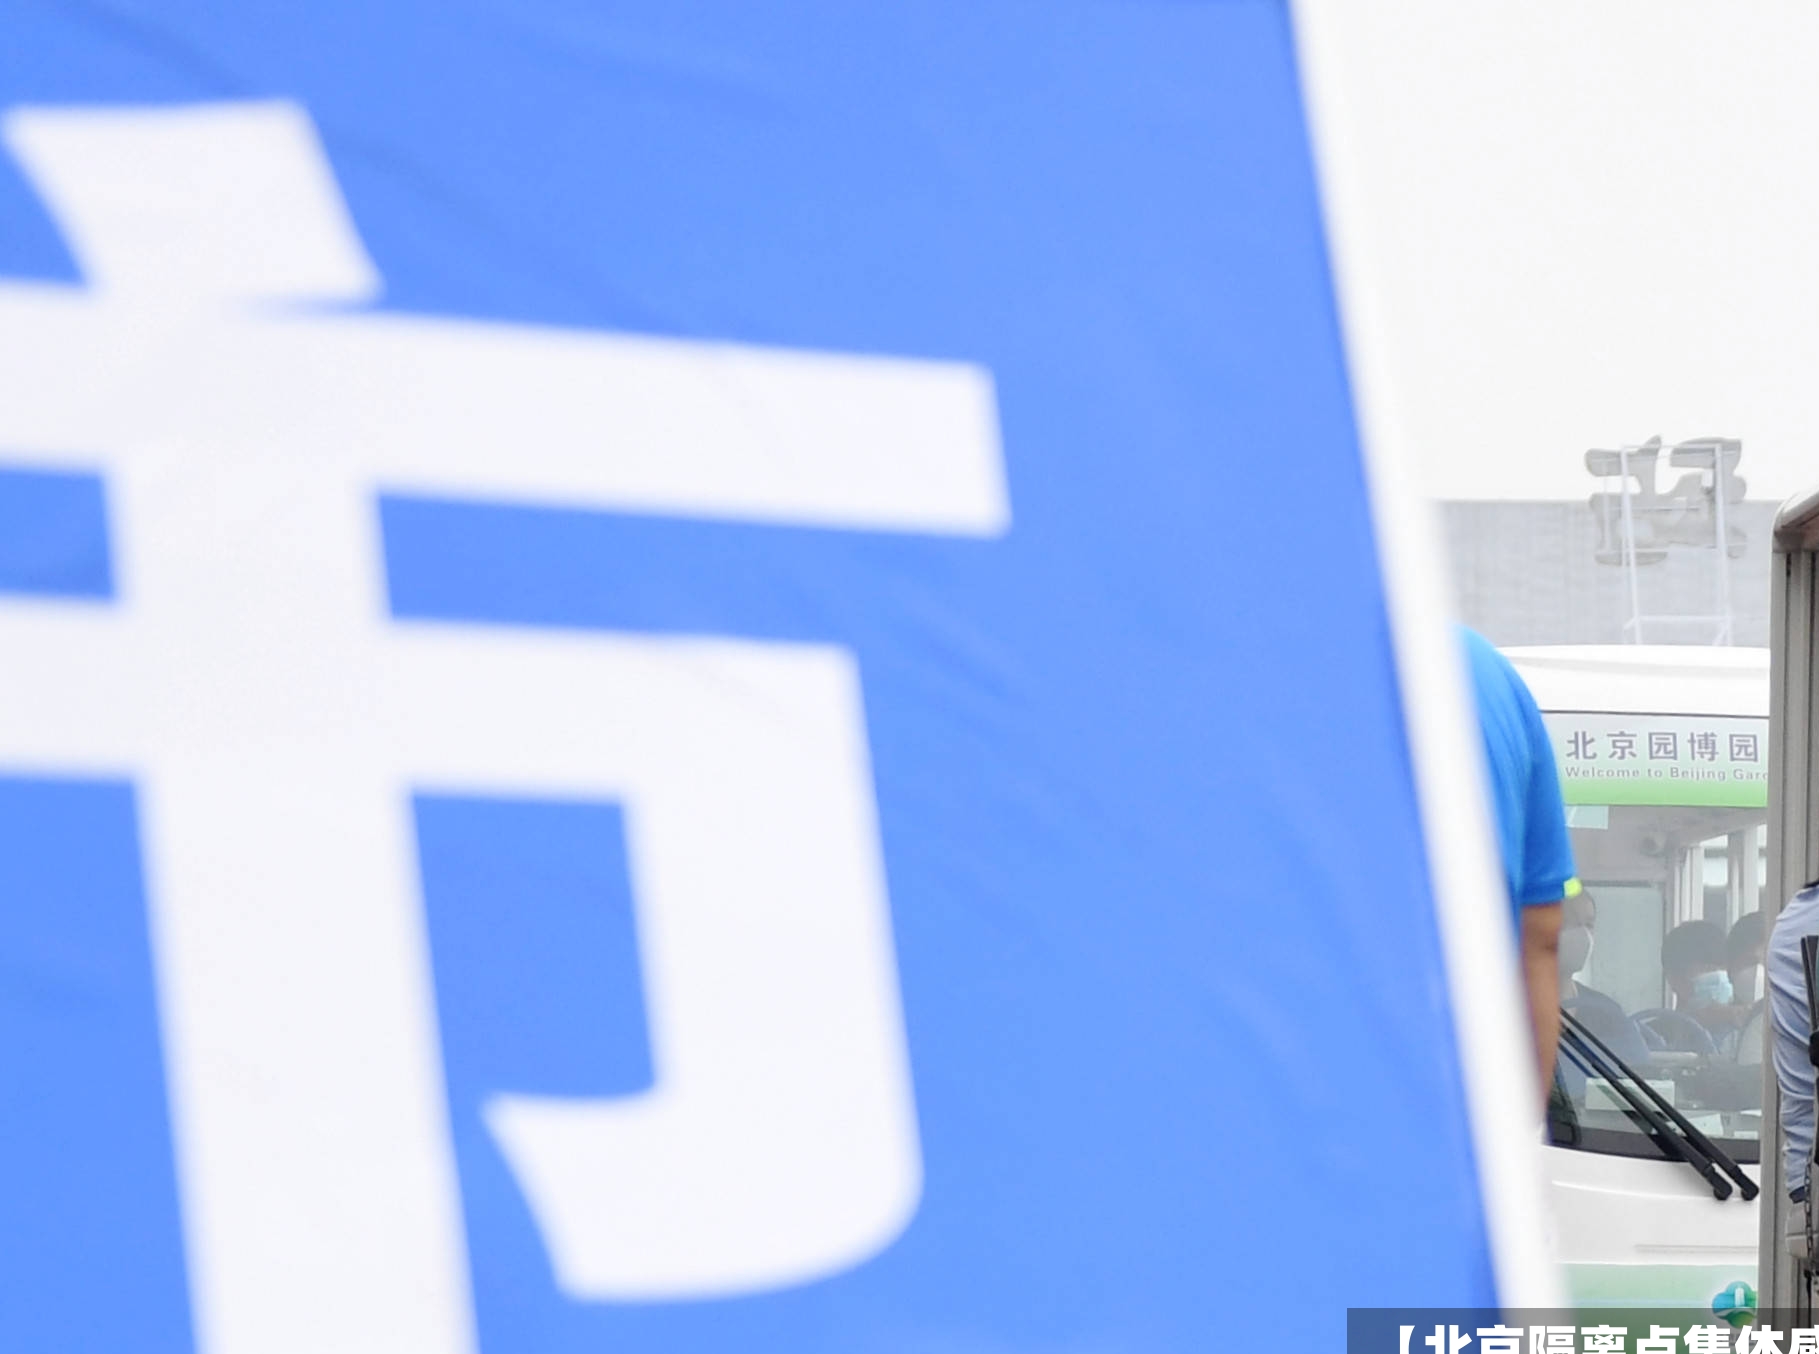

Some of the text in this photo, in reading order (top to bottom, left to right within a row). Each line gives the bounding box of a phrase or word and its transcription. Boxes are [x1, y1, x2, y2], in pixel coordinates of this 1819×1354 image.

[1566, 731, 1758, 762] 北京园博园
[1566, 766, 1640, 778] Welcome
[1648, 767, 1663, 778] to
[1670, 767, 1726, 781] Beijing
